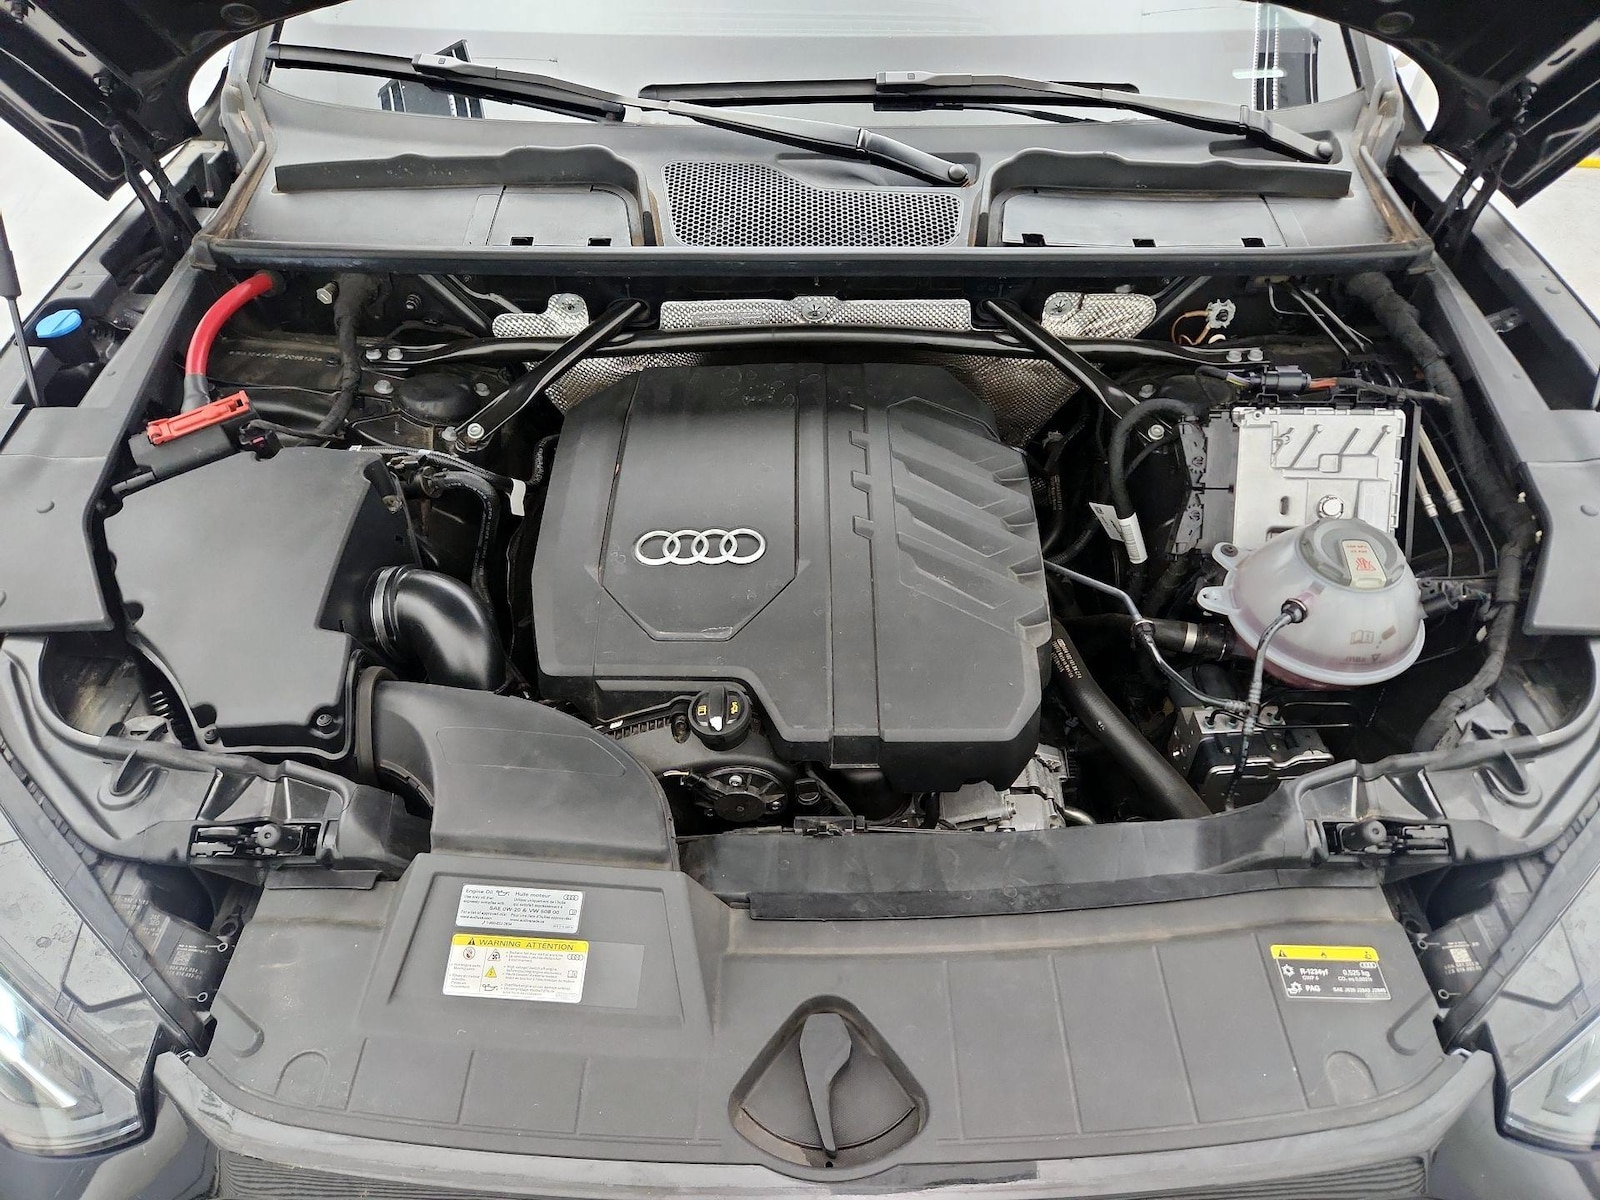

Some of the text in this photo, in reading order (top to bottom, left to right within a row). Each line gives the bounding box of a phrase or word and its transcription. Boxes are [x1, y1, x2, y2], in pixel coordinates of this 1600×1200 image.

[480, 939, 575, 951] WARNING ATTENTION
[1304, 984, 1321, 992] PAG
